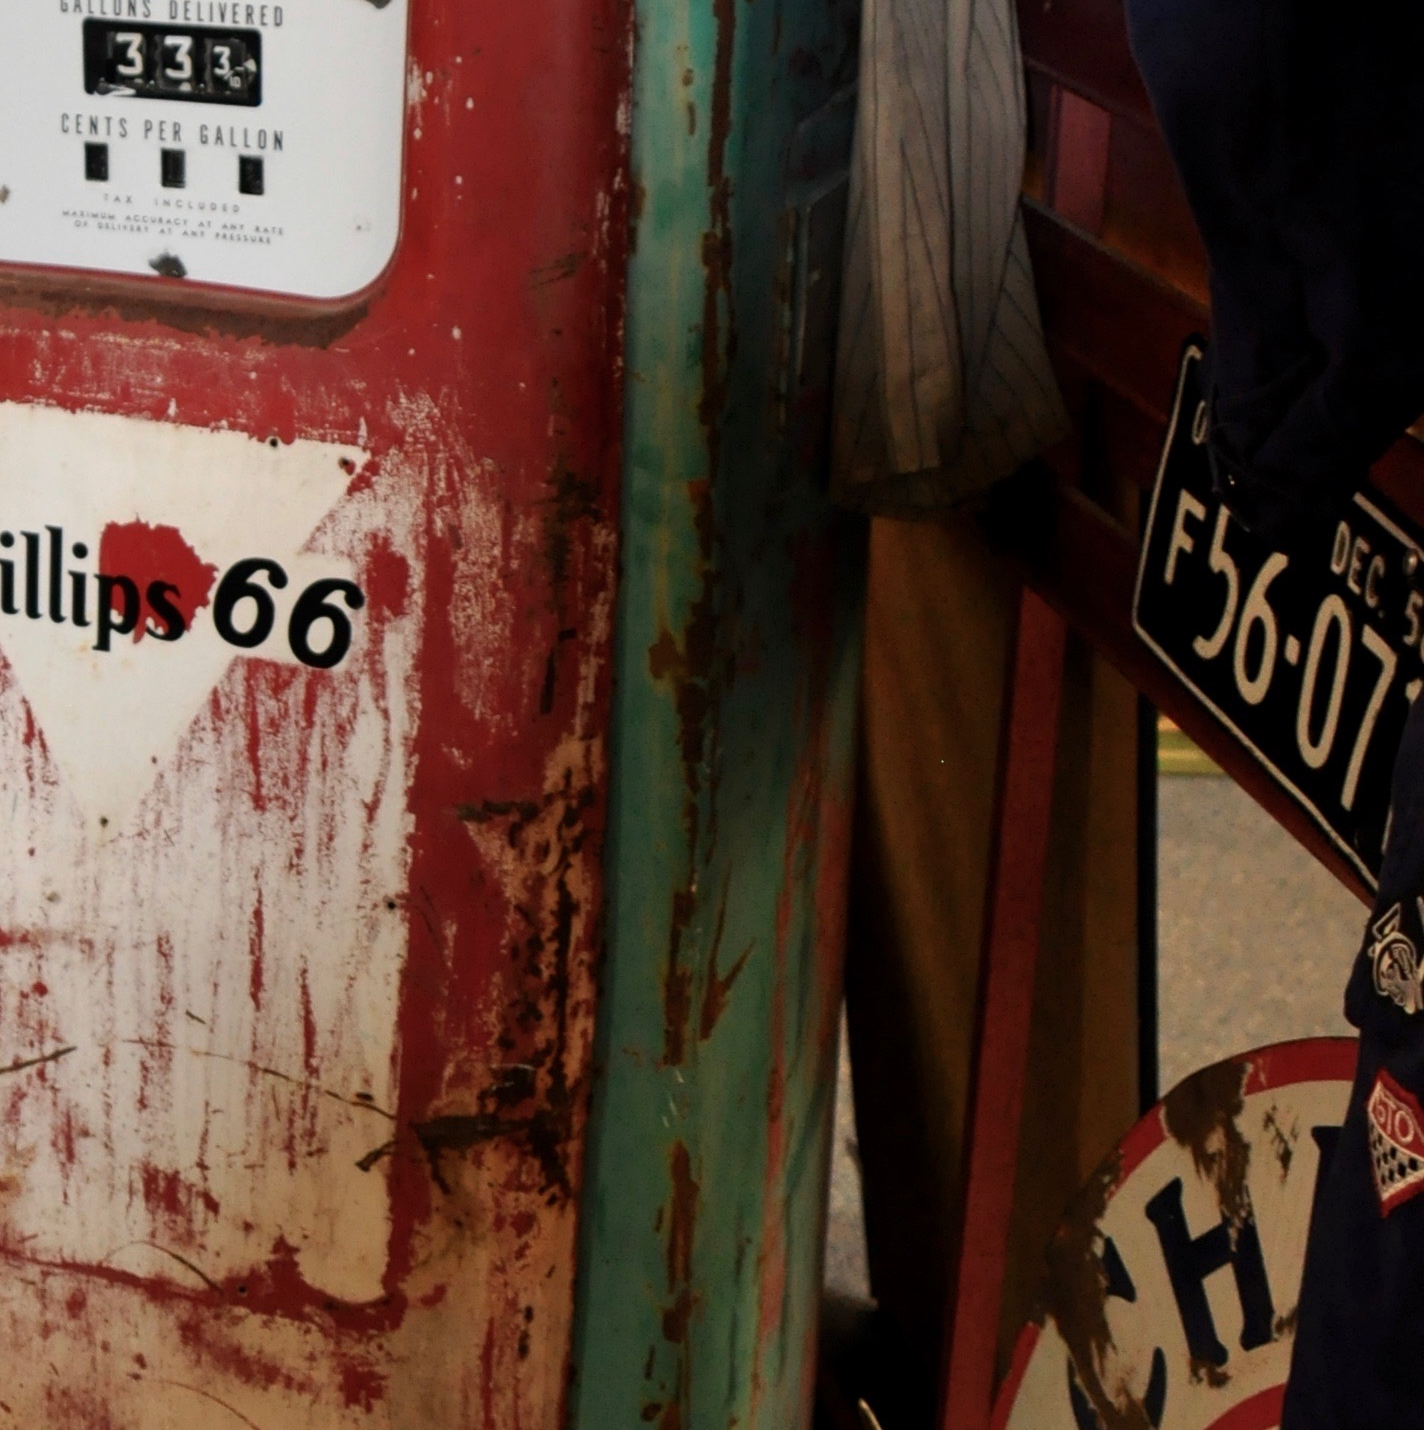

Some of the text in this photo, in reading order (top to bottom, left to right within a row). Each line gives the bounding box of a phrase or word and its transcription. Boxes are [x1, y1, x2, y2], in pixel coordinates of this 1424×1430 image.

[168, 0, 285, 28] DELIVERED
[60, 112, 285, 152] CENTS PER GALLON
[153, 197, 241, 214] INCLUDED
[212, 556, 366, 670] 66
